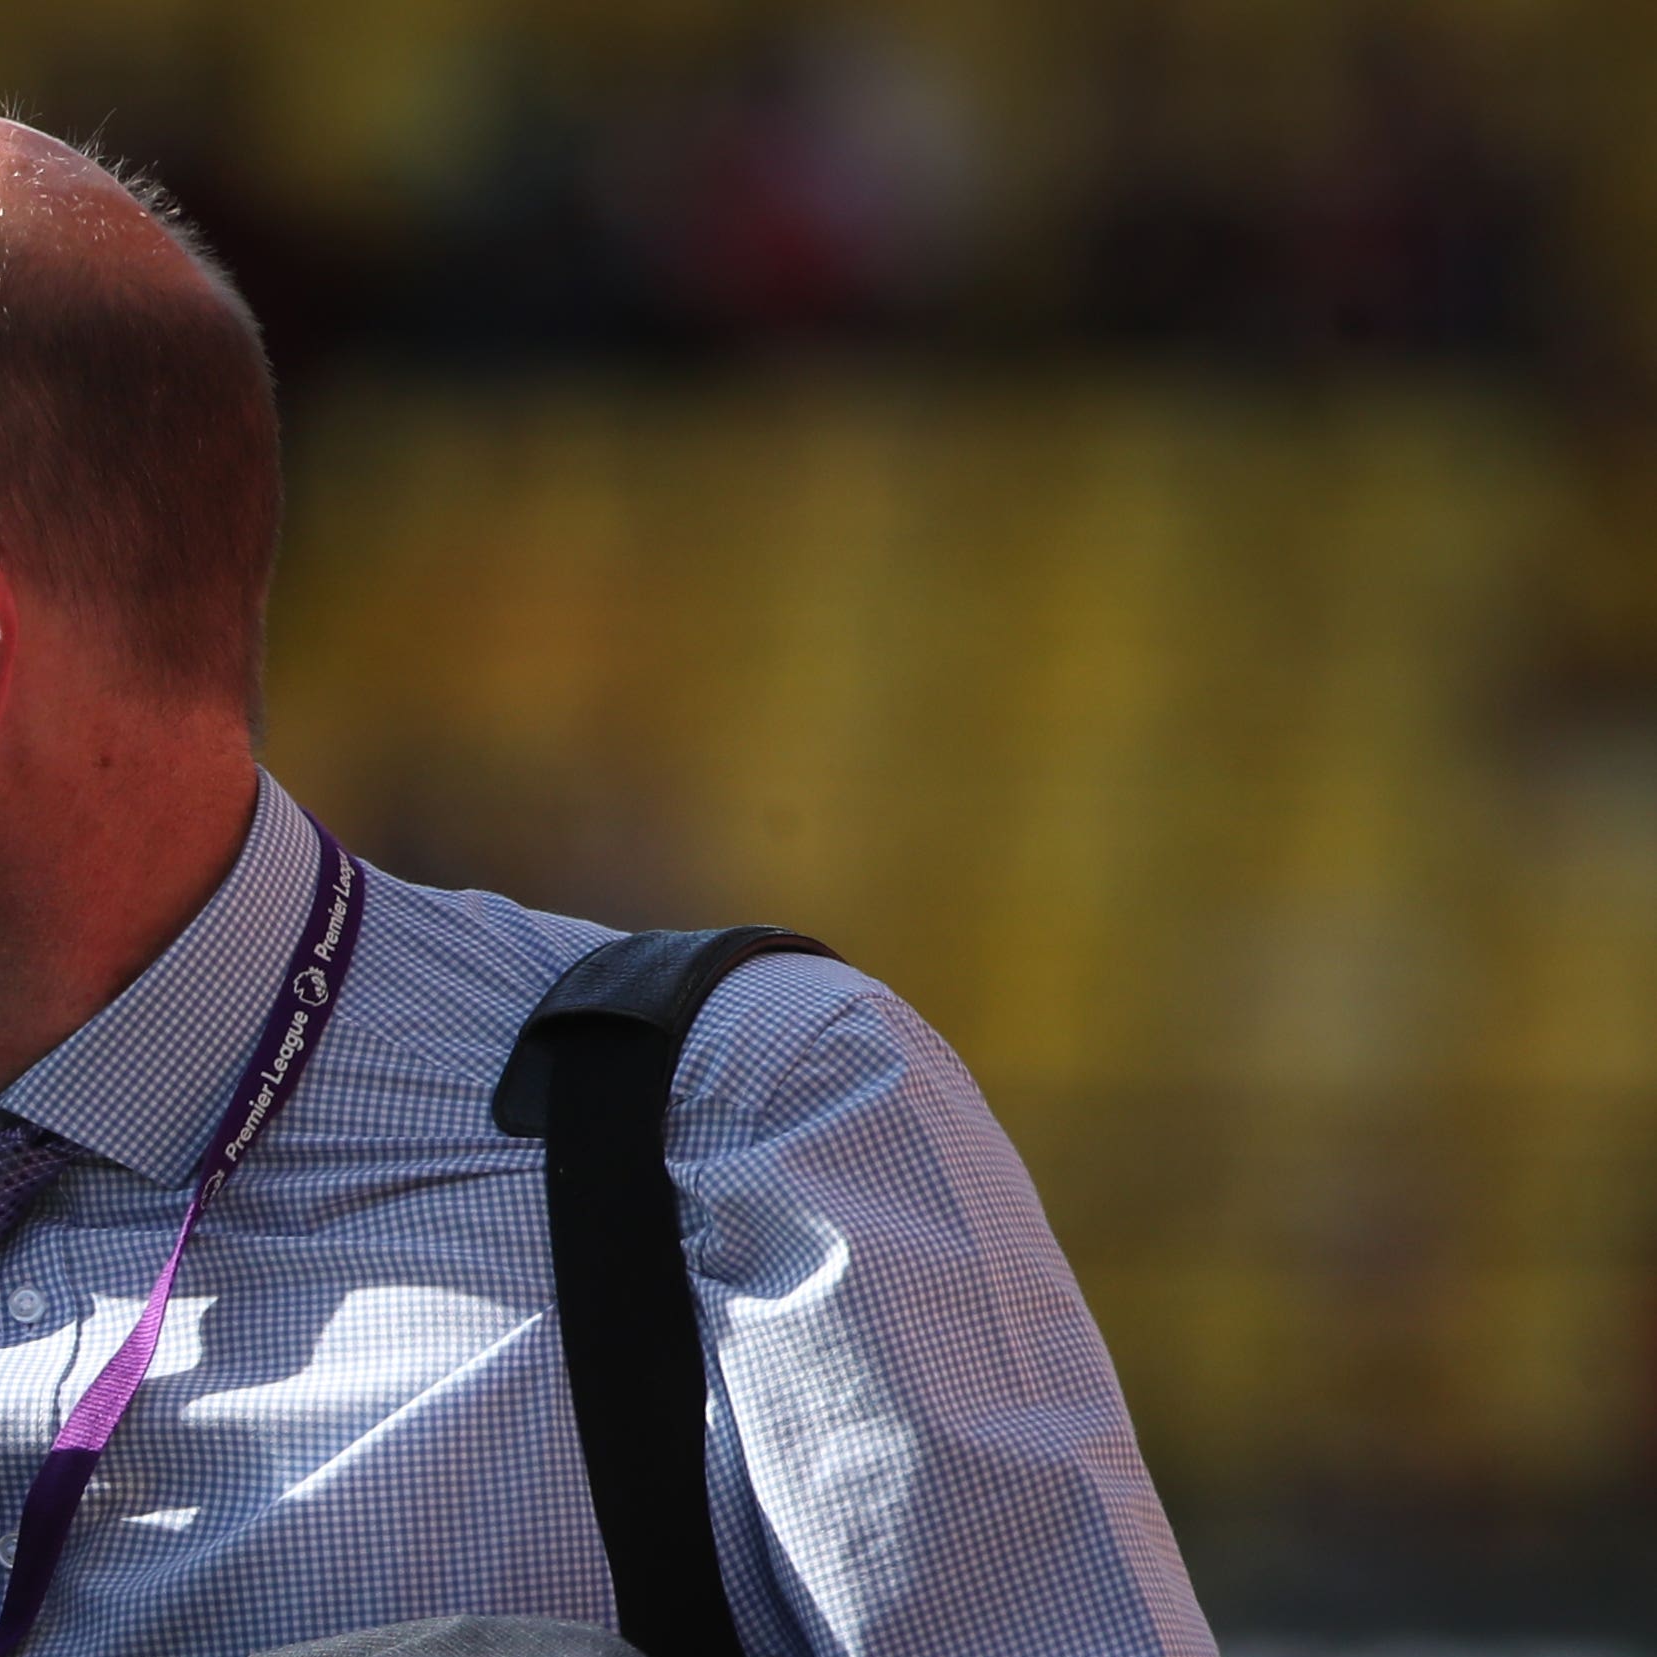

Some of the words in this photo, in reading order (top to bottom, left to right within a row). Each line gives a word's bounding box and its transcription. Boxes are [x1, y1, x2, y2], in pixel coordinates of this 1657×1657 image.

[314, 895, 348, 962] Premier
[225, 1083, 275, 1162] Premier
[260, 1010, 309, 1085] League
